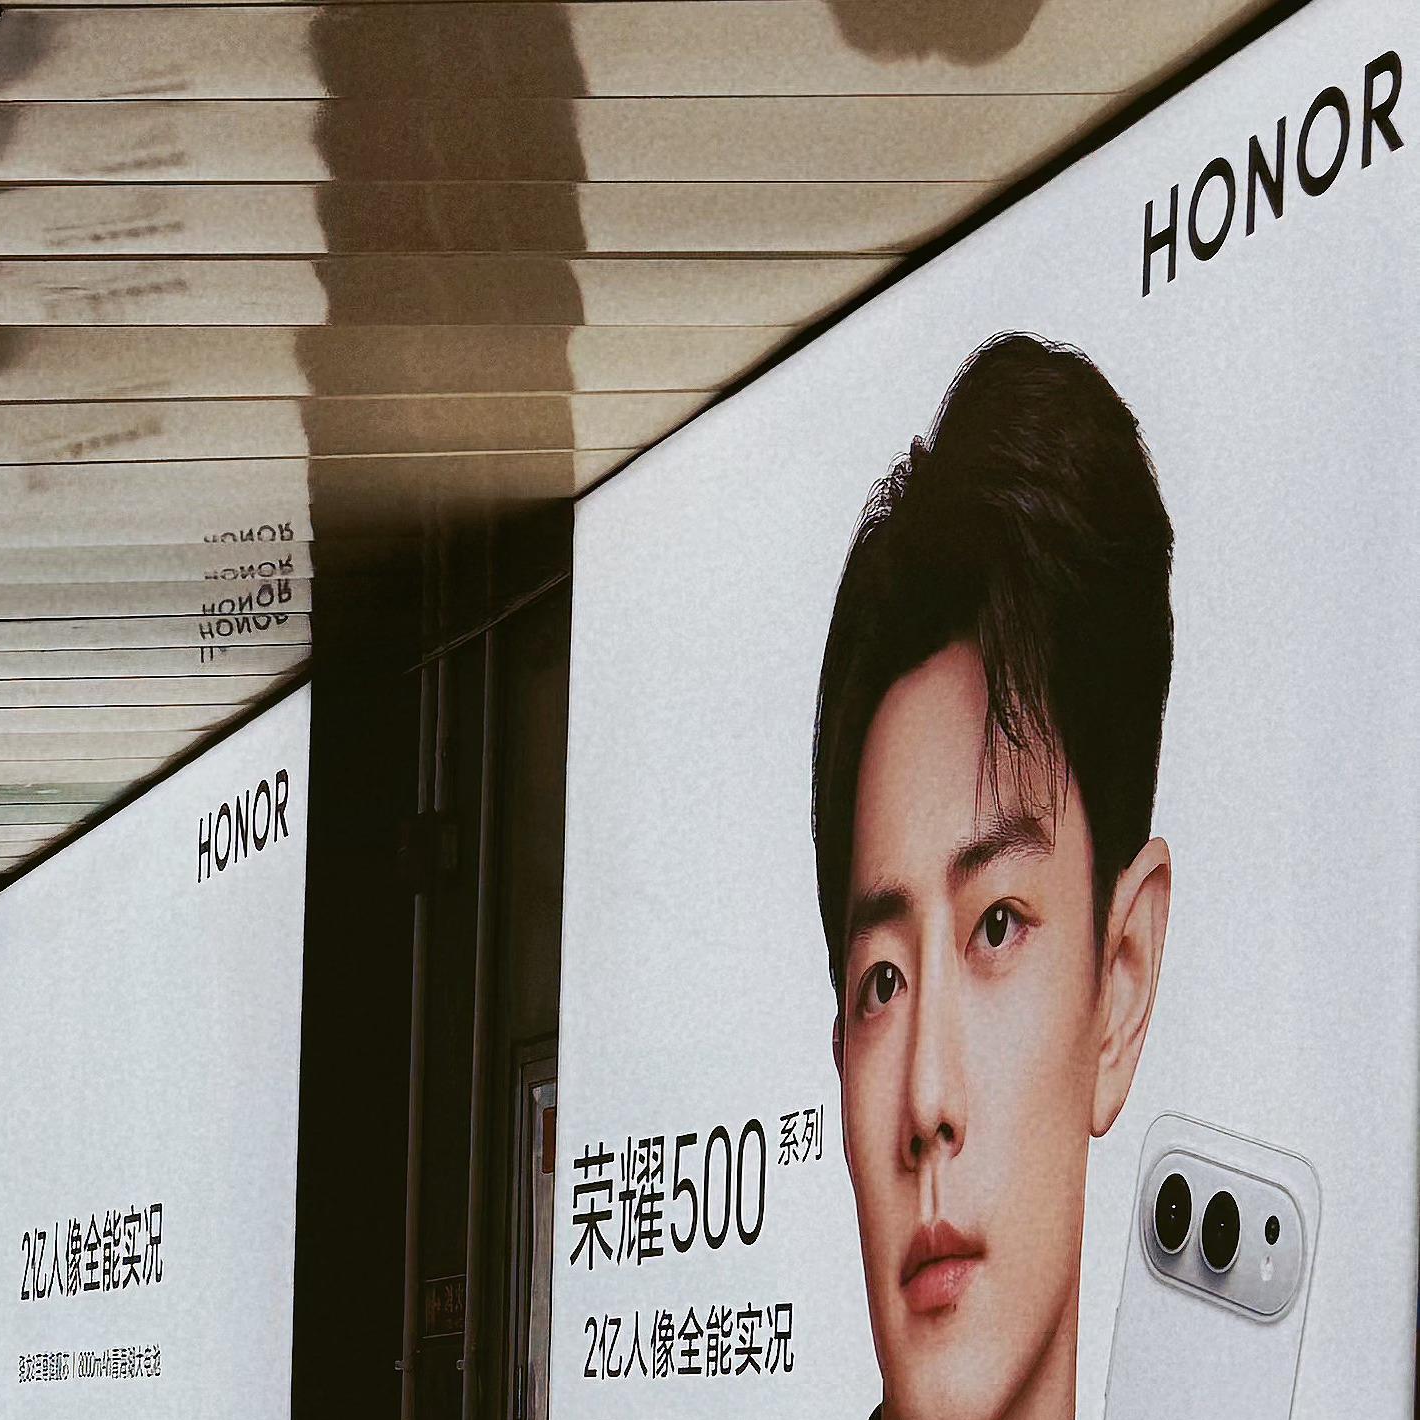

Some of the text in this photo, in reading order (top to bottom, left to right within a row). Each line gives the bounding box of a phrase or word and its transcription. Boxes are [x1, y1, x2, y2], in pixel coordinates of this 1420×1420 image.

[1142, 50, 1404, 298] HONOR
[197, 768, 289, 883] HONOR
[570, 1104, 823, 1270] 荣耀500 系列
[20, 1203, 163, 1302] 2亿人像全能实况
[583, 1302, 794, 1380] 2亿人像全能实况
